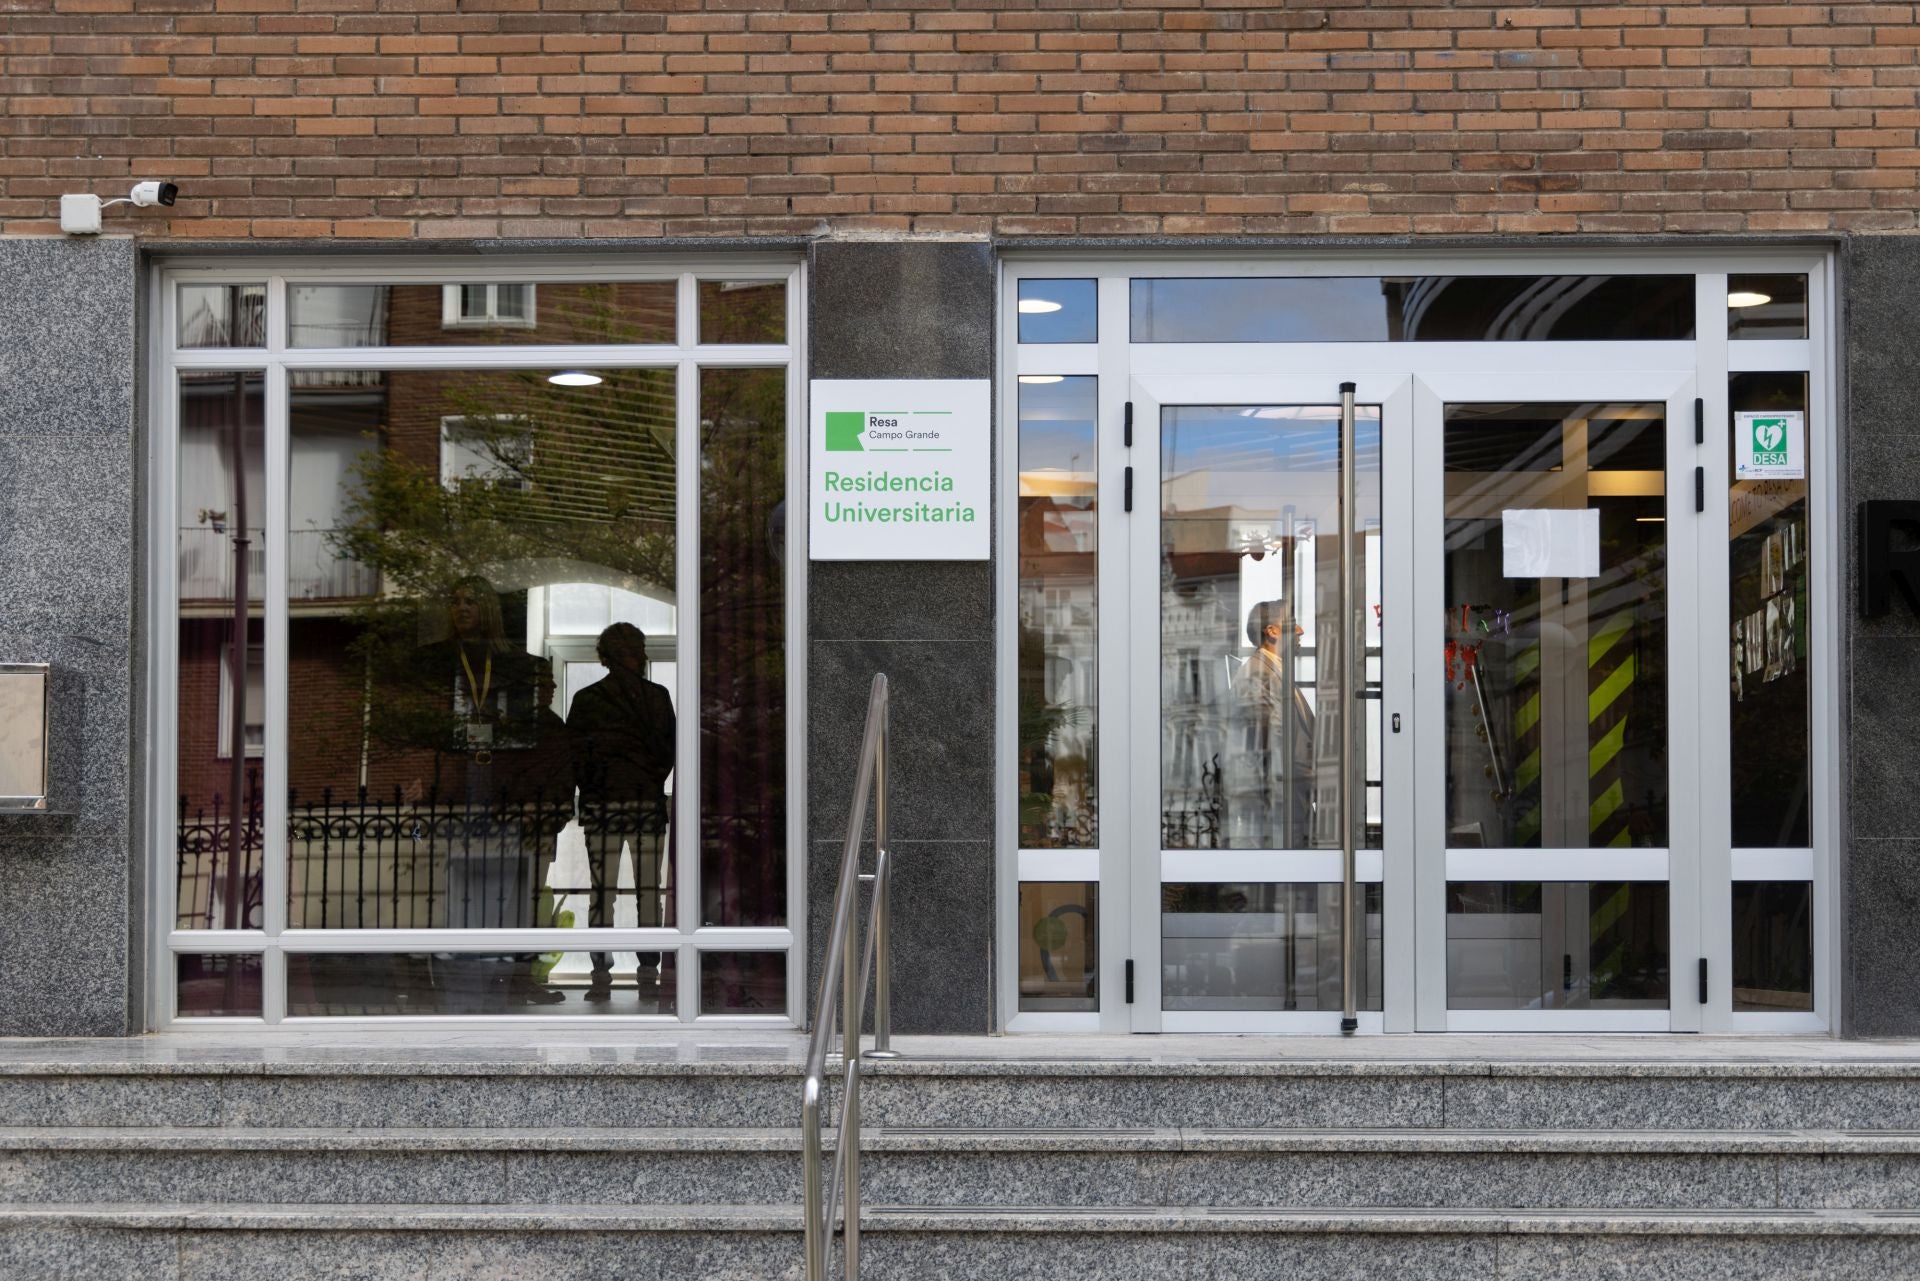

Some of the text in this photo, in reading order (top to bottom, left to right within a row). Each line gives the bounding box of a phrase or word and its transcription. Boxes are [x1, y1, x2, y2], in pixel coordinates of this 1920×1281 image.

[869, 416, 898, 427] Resa
[869, 430, 940, 440] Campo Grande
[1753, 453, 1786, 465] DESA
[825, 471, 953, 492] Residencia
[825, 502, 975, 522] Universitaria
